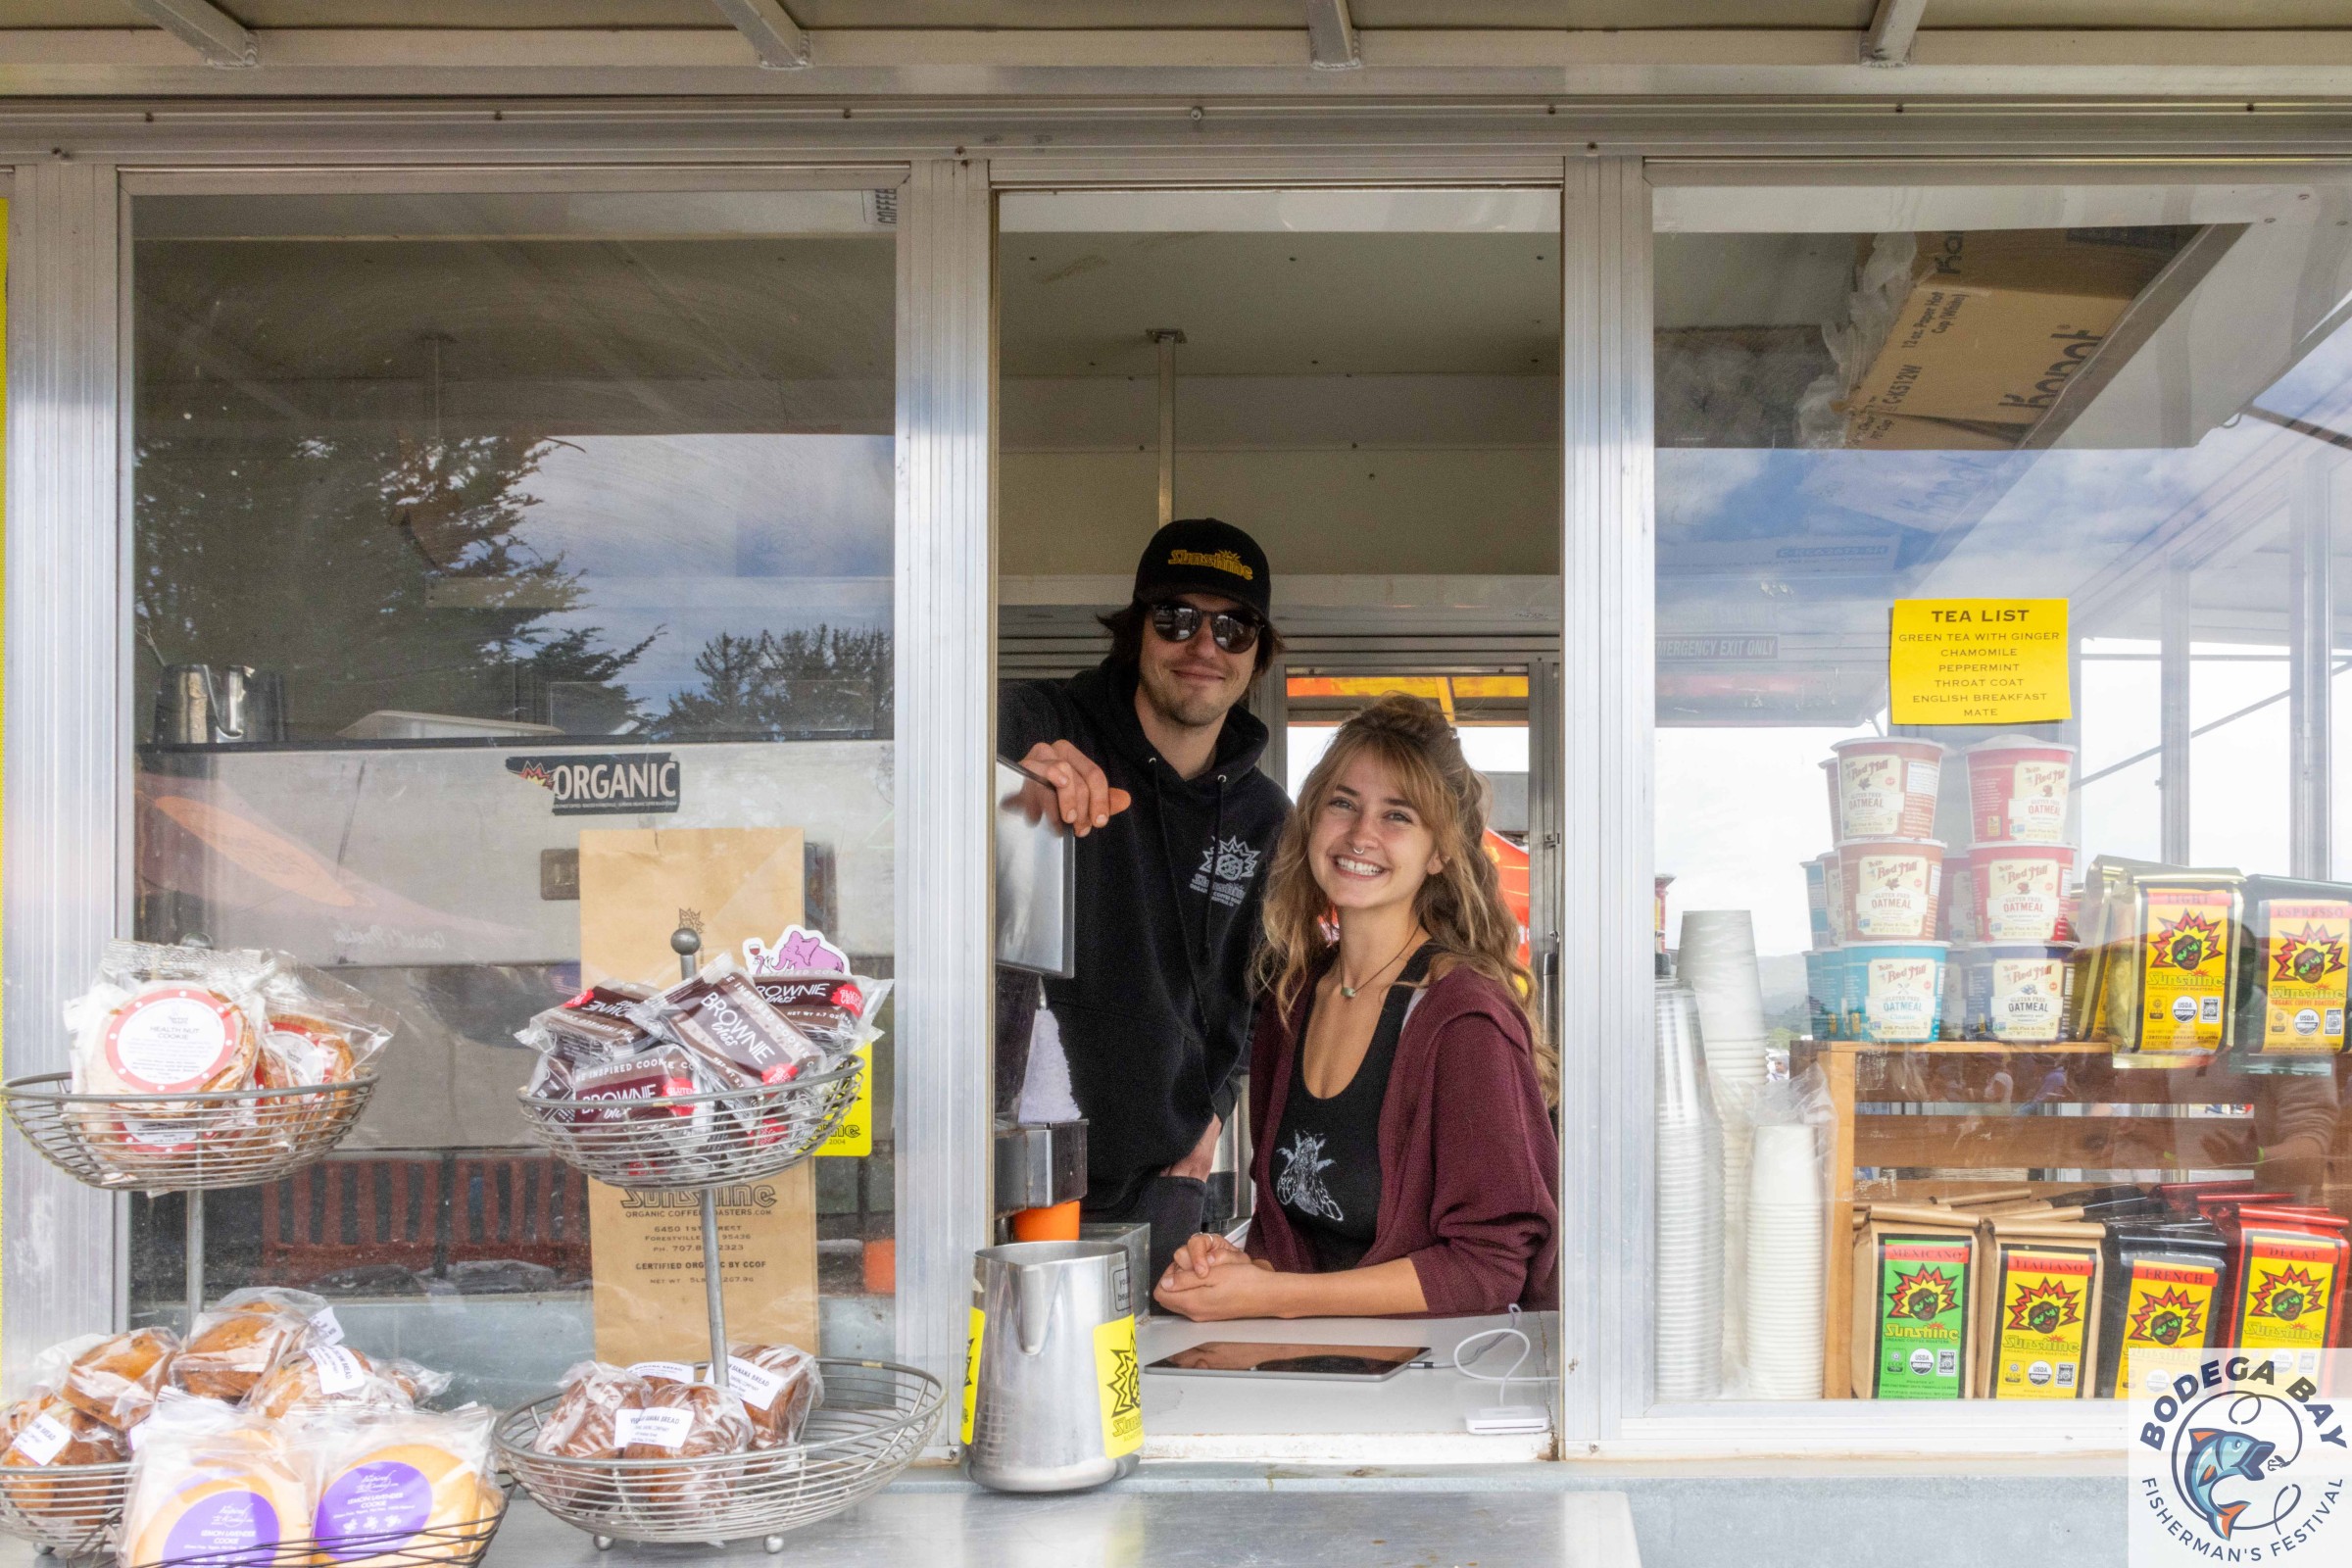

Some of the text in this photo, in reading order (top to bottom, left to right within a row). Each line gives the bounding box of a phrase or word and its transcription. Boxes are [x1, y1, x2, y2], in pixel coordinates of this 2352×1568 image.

[1168, 549, 1253, 580] Sunshine
[1932, 610, 2030, 622] TEA LIST
[1720, 639, 1745, 657] EXIT
[1747, 639, 1775, 657] ONLY
[1939, 663, 2020, 672] PEPPERMINT
[1974, 693, 2047, 702] BREAKFAST
[553, 762, 676, 800] ORGANIC
[1849, 798, 1884, 809] OATMEAL
[2029, 805, 2060, 815] OATMEAL
[1878, 861, 1917, 880] Red Mill
[2008, 864, 2048, 884] Red Mill
[1872, 899, 1911, 909] OATMEAL
[2167, 894, 2209, 904] LIGHT
[2003, 903, 2043, 912] OATMEAL
[2277, 906, 2343, 917] ESPRESSO
[1888, 964, 1927, 983] Red Mill
[2013, 965, 2052, 983] Red Mill
[2147, 971, 2225, 986] Sunshine
[757, 983, 830, 997] ROWNIE
[2270, 986, 2345, 999] Sunshine
[1884, 1002, 1922, 1011] OATMEAL
[2008, 1003, 2048, 1012] OATMEAL
[733, 982, 810, 1059] INSPIRED COOKIE
[701, 992, 775, 1065] BROWNIE
[711, 1022, 738, 1047] bless
[587, 1063, 632, 1078] INSPIRED
[637, 1058, 674, 1070] COOKIE
[620, 1185, 777, 1208] Sunsine
[1893, 1249, 1962, 1259] MEXICANO
[2270, 1248, 2319, 1259] DECAF
[2015, 1259, 2083, 1272] ITALIANO
[2145, 1269, 2204, 1284] FRENCH
[1885, 1323, 1960, 1340] Sunshine
[2244, 1322, 2323, 1341] Sunshine
[2003, 1335, 2080, 1352] Sunshine
[661, 1415, 679, 1424] BREAD
[347, 1496, 370, 1505] LEMON
